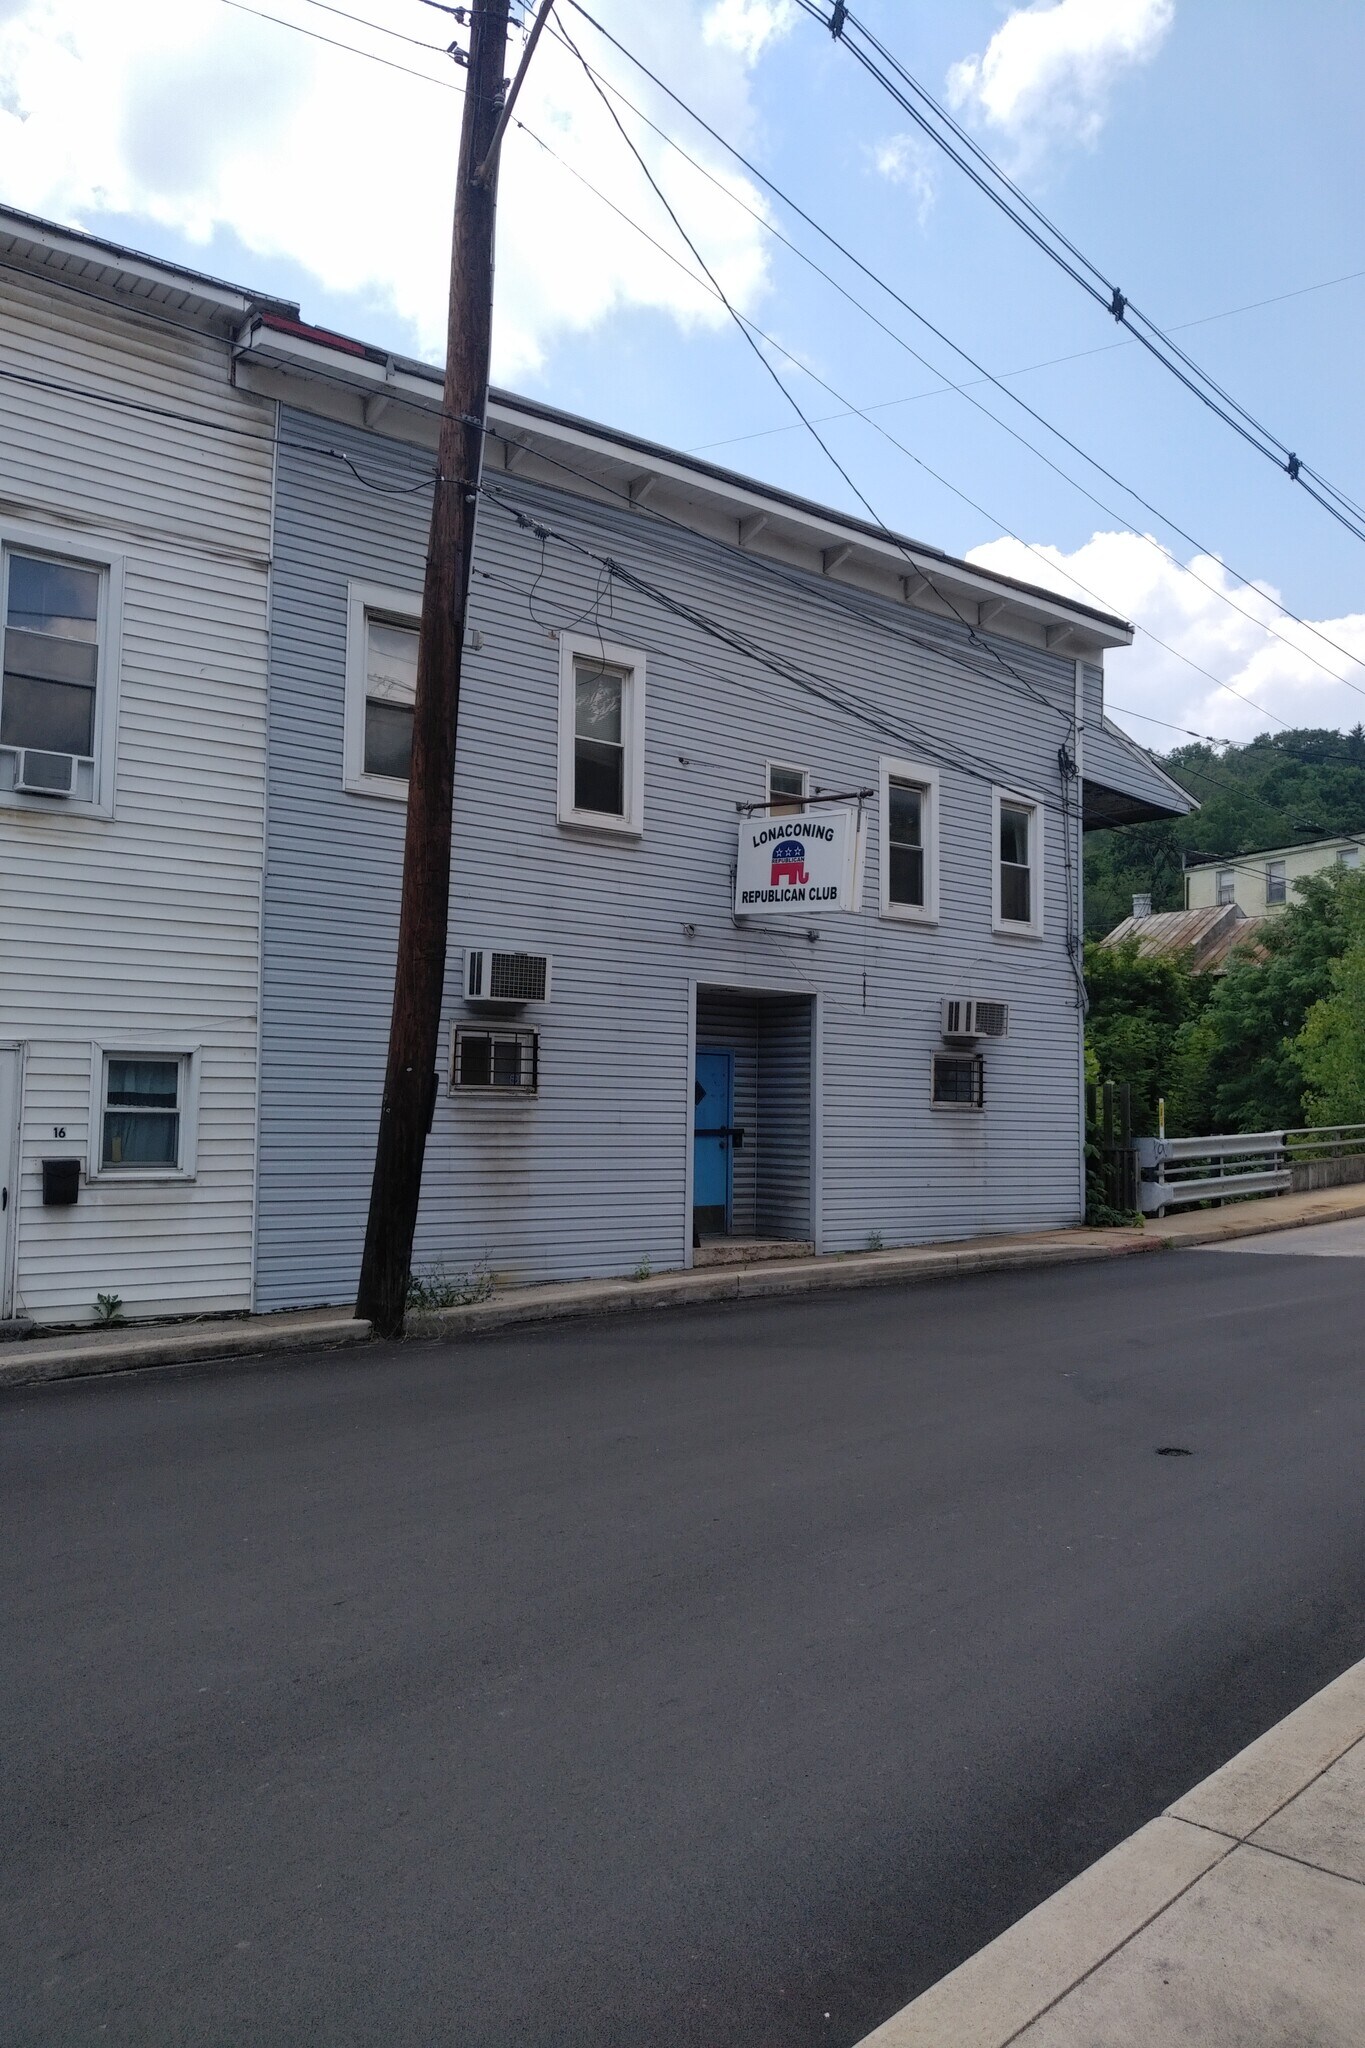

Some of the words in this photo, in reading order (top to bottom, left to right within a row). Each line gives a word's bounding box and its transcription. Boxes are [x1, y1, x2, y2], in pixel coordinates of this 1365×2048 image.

[752, 823, 834, 848] LONACONING
[742, 888, 806, 903] REPUBLICAN
[809, 887, 837, 901] CLUB
[53, 1127, 66, 1138] 16
